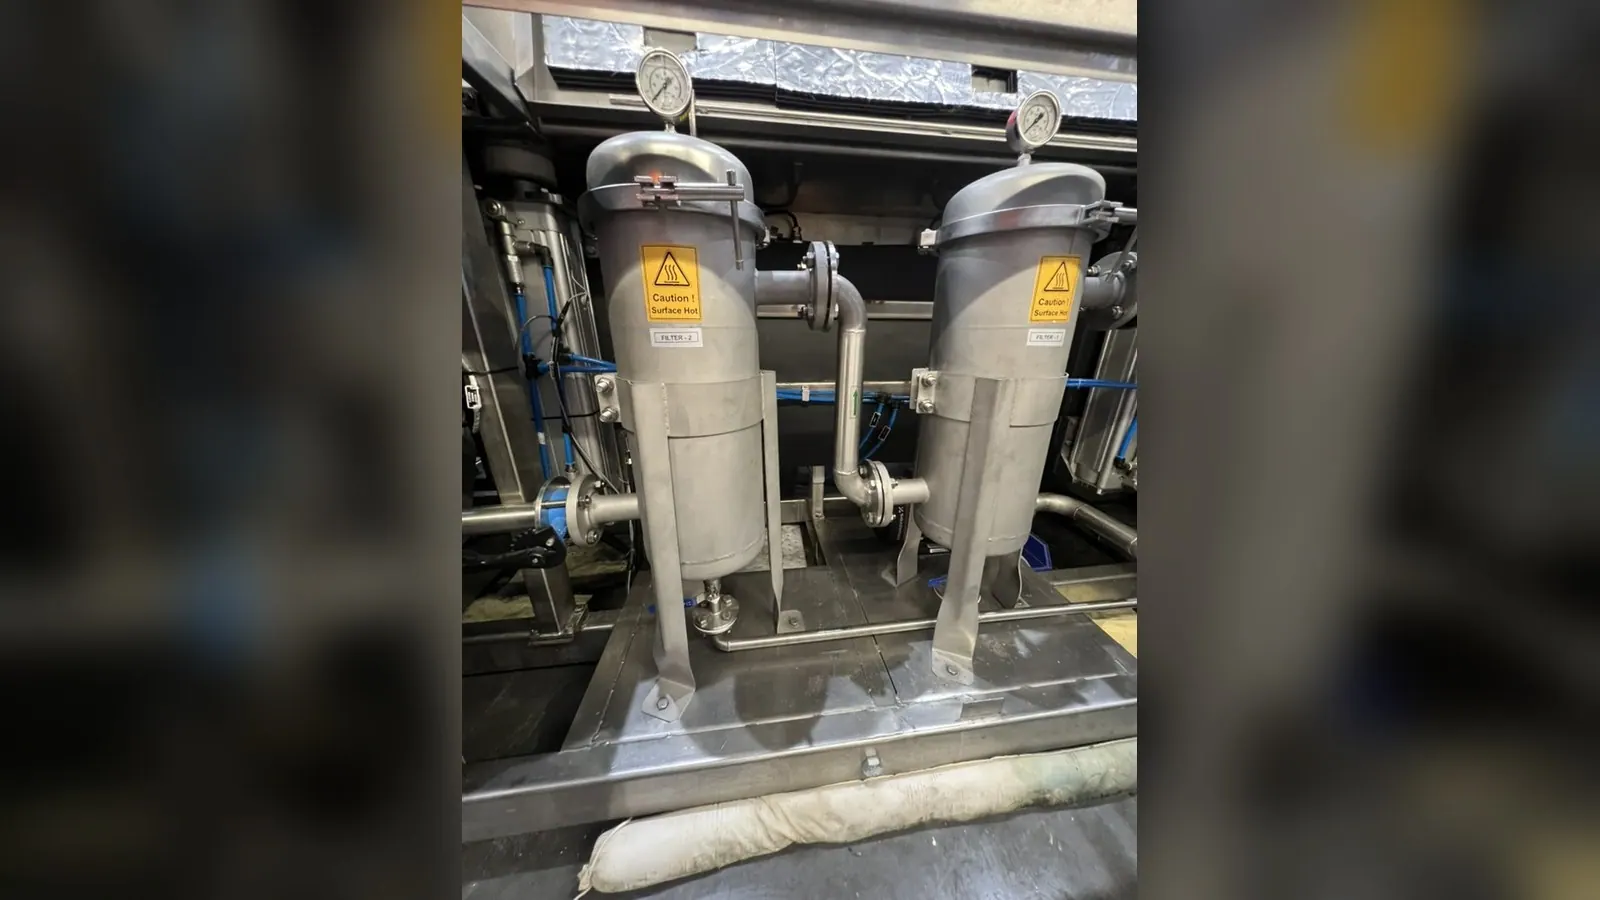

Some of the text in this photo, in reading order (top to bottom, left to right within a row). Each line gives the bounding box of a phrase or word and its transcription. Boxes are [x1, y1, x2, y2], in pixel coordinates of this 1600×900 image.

[652, 293, 689, 302] Caution
[1038, 298, 1065, 306] Caution
[651, 306, 682, 314] Surface
